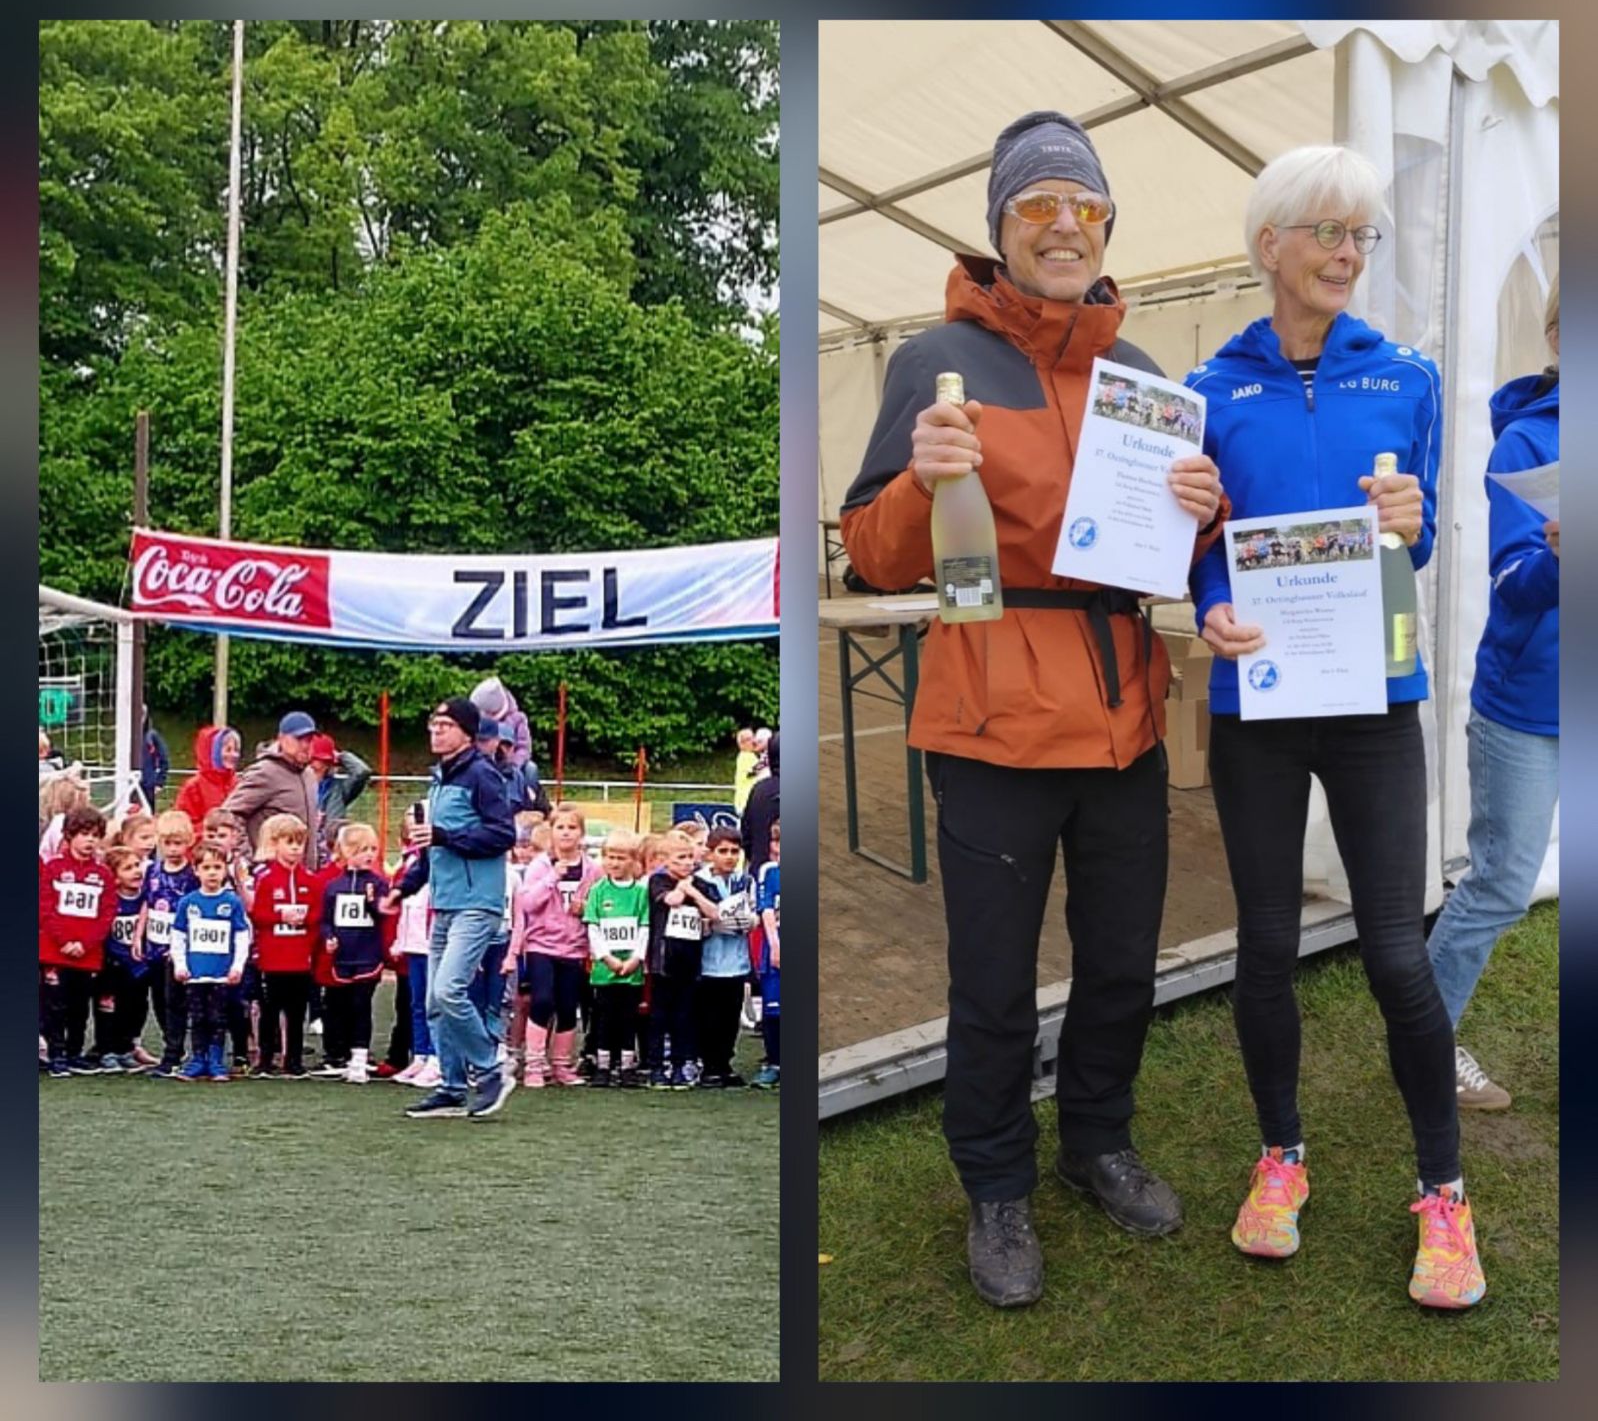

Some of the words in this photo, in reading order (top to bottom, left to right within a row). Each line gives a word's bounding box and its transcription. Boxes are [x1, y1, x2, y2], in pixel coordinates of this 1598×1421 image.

[1231, 383, 1263, 400] JAKO
[1361, 377, 1400, 392] BURG
[1122, 433, 1176, 459] Urkunde
[1276, 572, 1338, 588] Urkunde
[452, 568, 648, 639] ZIEL
